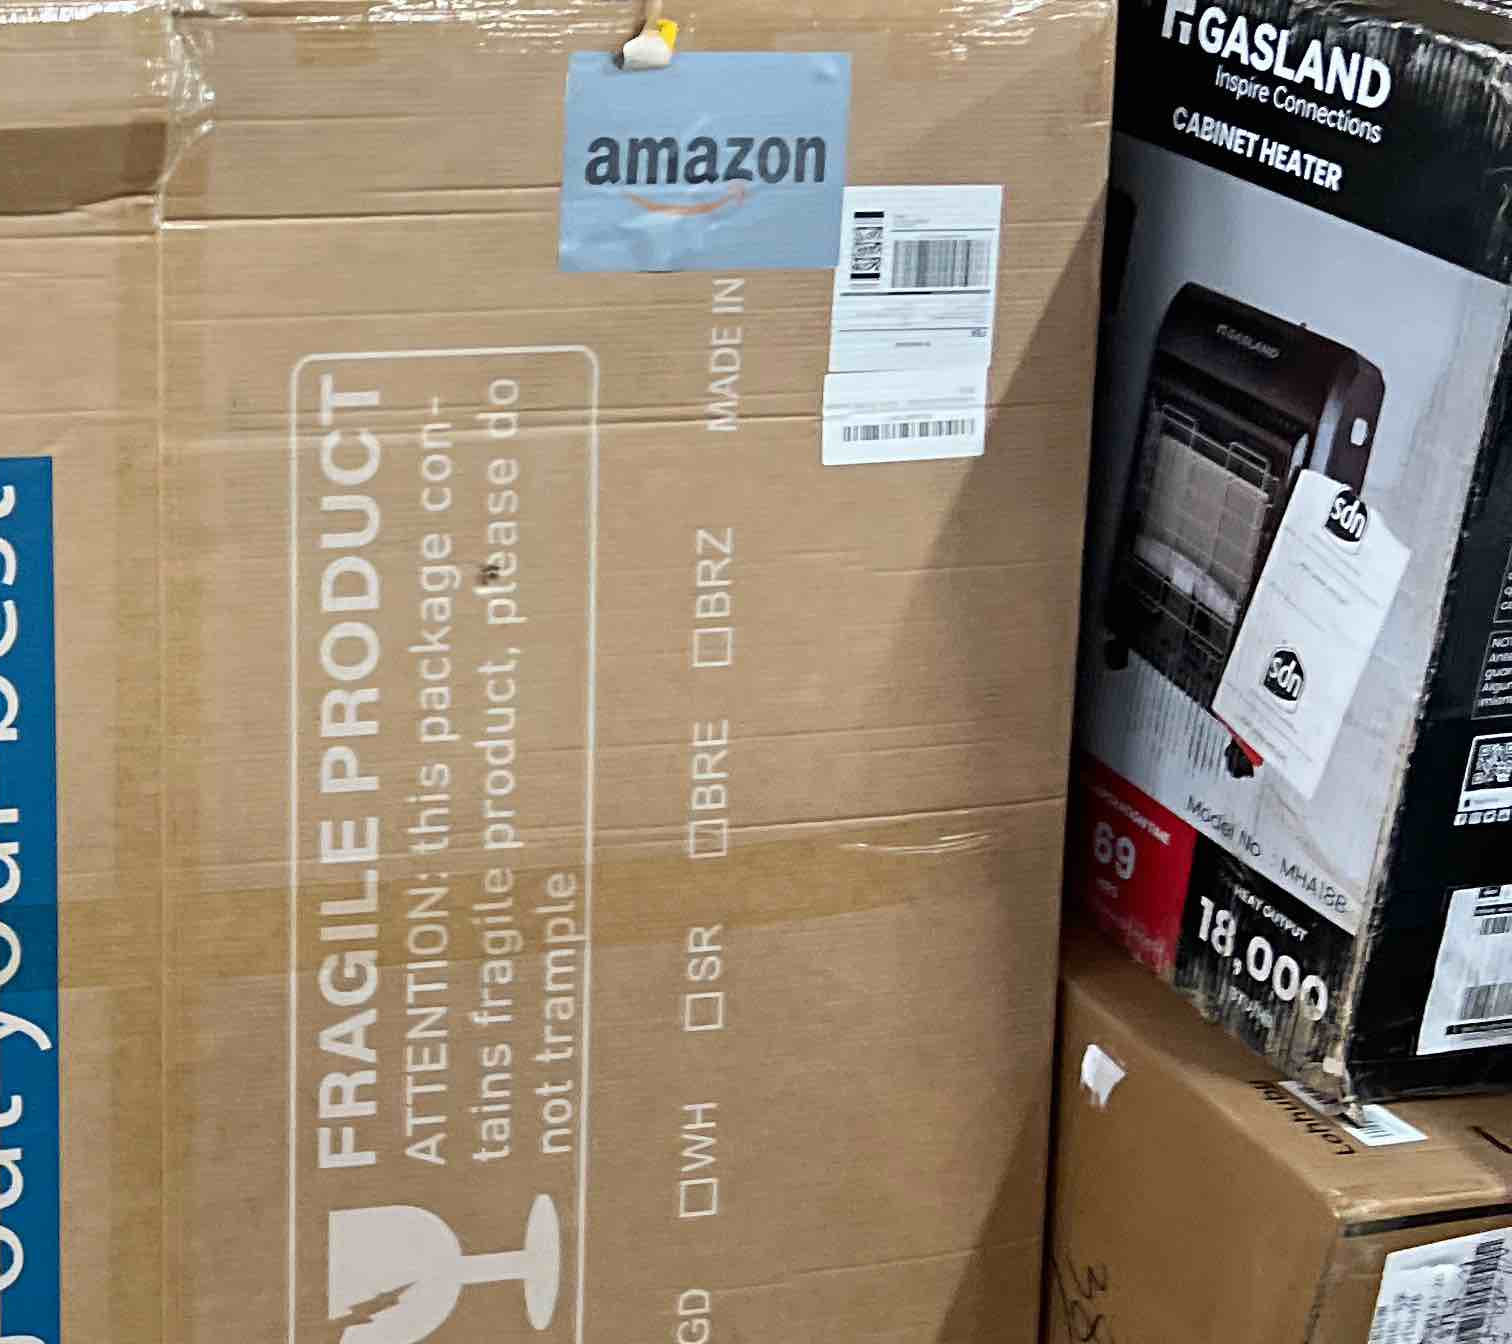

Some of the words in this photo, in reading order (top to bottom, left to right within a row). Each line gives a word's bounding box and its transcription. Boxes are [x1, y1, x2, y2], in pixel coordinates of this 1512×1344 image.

[1197, 5, 1392, 109] GASLAND
[1172, 106, 1261, 158] CABINET
[1259, 138, 1343, 192] HEATER
[1215, 64, 1271, 104] Inspire
[1273, 85, 1384, 144] Connections
[584, 134, 828, 187] amazon
[712, 276, 746, 315] IN
[474, 378, 521, 441] do
[706, 325, 745, 433] MADE
[419, 396, 453, 513] con-
[472, 457, 529, 625] please
[1329, 495, 1368, 539] sdn
[319, 372, 382, 794] PRODUCT
[695, 527, 735, 619] BRZ
[407, 533, 462, 744] package
[1268, 656, 1304, 698] sdn
[473, 647, 526, 850] product,
[691, 719, 729, 810] BRE
[407, 763, 452, 854] this
[1094, 821, 1136, 880] 69
[1187, 795, 1235, 841] Model
[471, 866, 524, 1025] fragile
[535, 872, 590, 1064] trample
[688, 923, 724, 982] SR
[1197, 895, 1329, 1022] 18,000
[317, 816, 380, 1170] FRAGILE
[406, 871, 451, 1167] ATTENTION:
[470, 1042, 514, 1163] tains
[535, 1079, 574, 1155] not
[680, 1102, 718, 1173] WH
